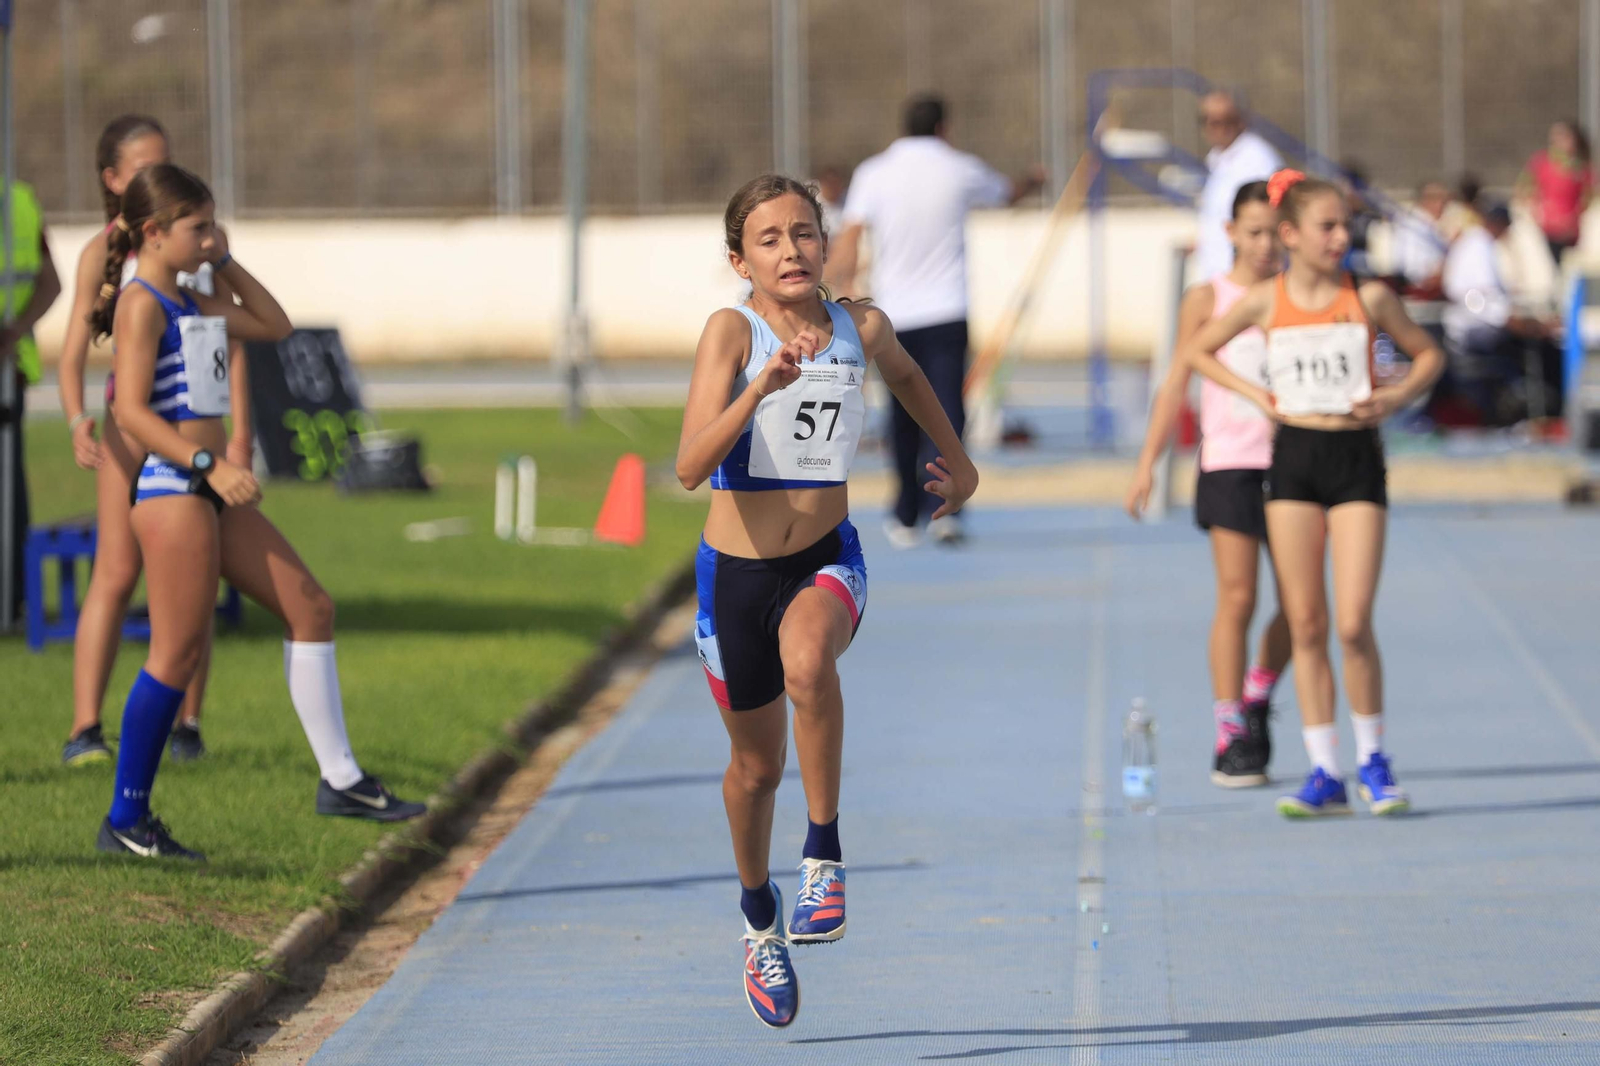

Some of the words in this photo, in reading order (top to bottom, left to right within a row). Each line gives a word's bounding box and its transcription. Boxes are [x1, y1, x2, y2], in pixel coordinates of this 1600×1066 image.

[213, 347, 226, 383] 8
[1293, 351, 1349, 386] 103
[793, 401, 842, 441] 57
